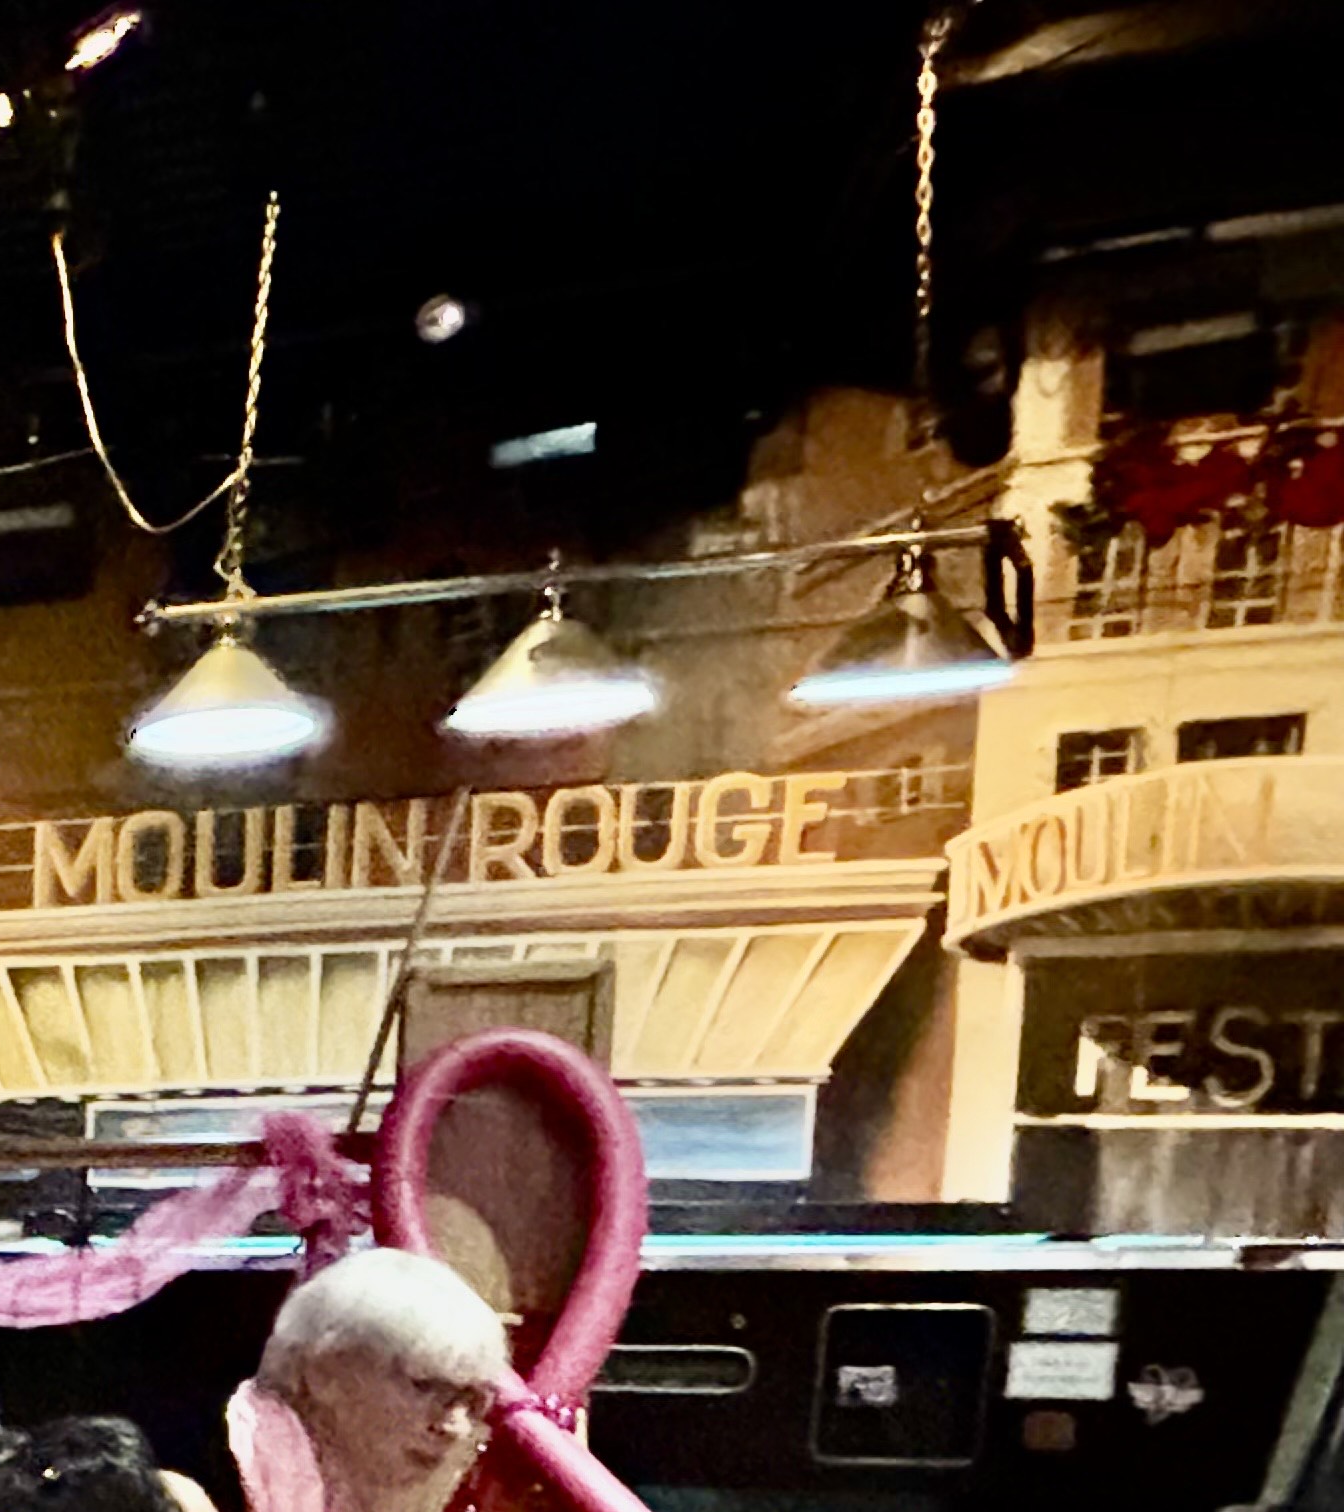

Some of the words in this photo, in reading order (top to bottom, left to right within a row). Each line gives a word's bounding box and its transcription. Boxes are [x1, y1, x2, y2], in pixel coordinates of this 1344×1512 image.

[33, 797, 428, 910] MOULIN
[469, 771, 848, 884] ROUGE
[968, 772, 1277, 920] MOULIN
